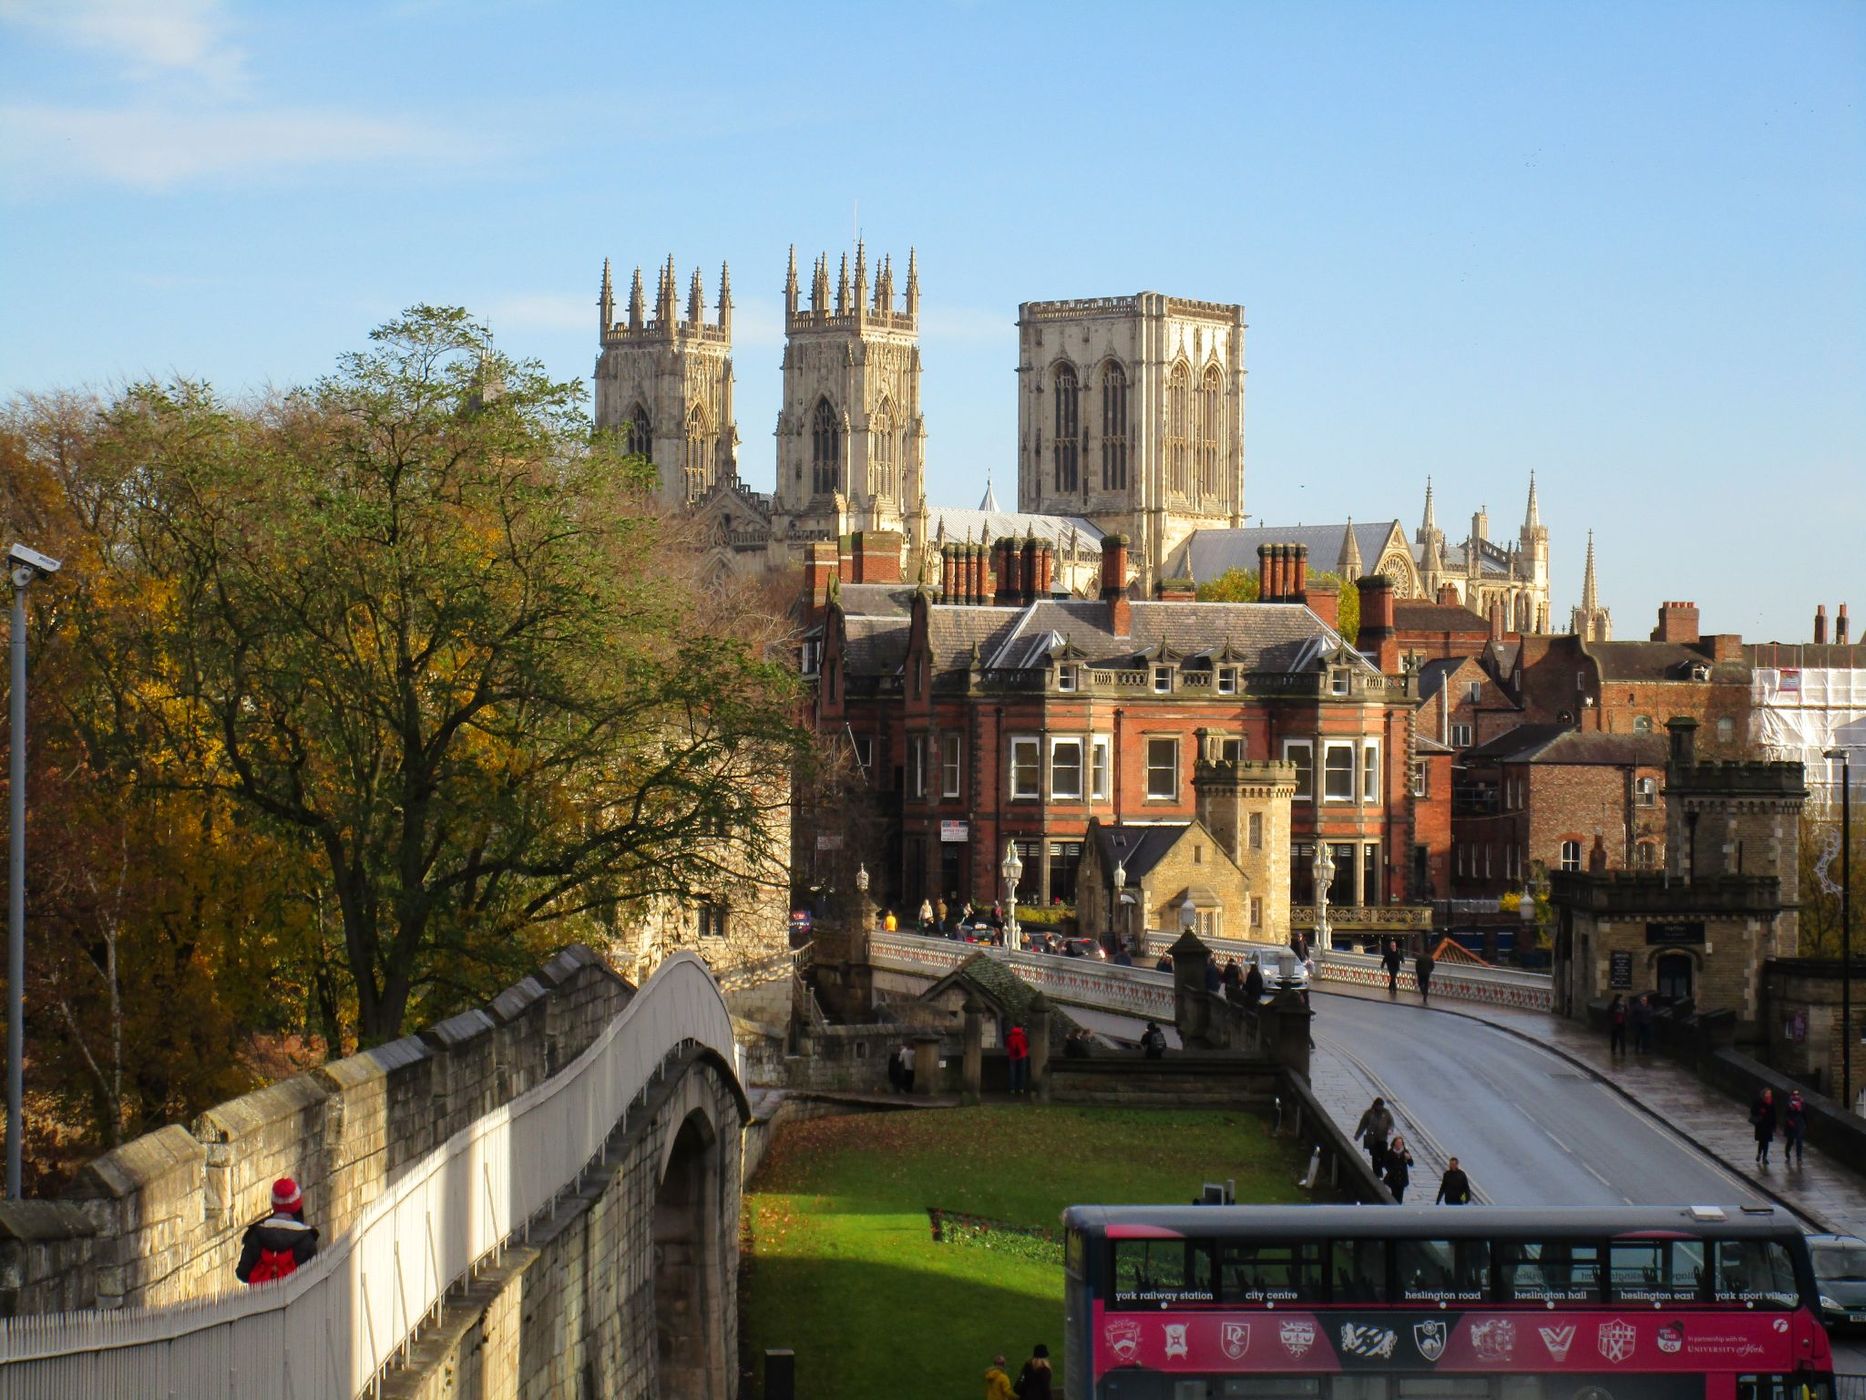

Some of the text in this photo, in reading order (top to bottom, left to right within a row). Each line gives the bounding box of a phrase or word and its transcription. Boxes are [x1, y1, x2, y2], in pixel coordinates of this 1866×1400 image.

[1116, 1291, 1213, 1301] york railway station
[1245, 1291, 1298, 1301] city centre
[1405, 1291, 1481, 1301] heslington road
[1514, 1290, 1587, 1301] heslington hall
[1621, 1291, 1695, 1301] heslington east
[1715, 1291, 1800, 1301] york sport village
